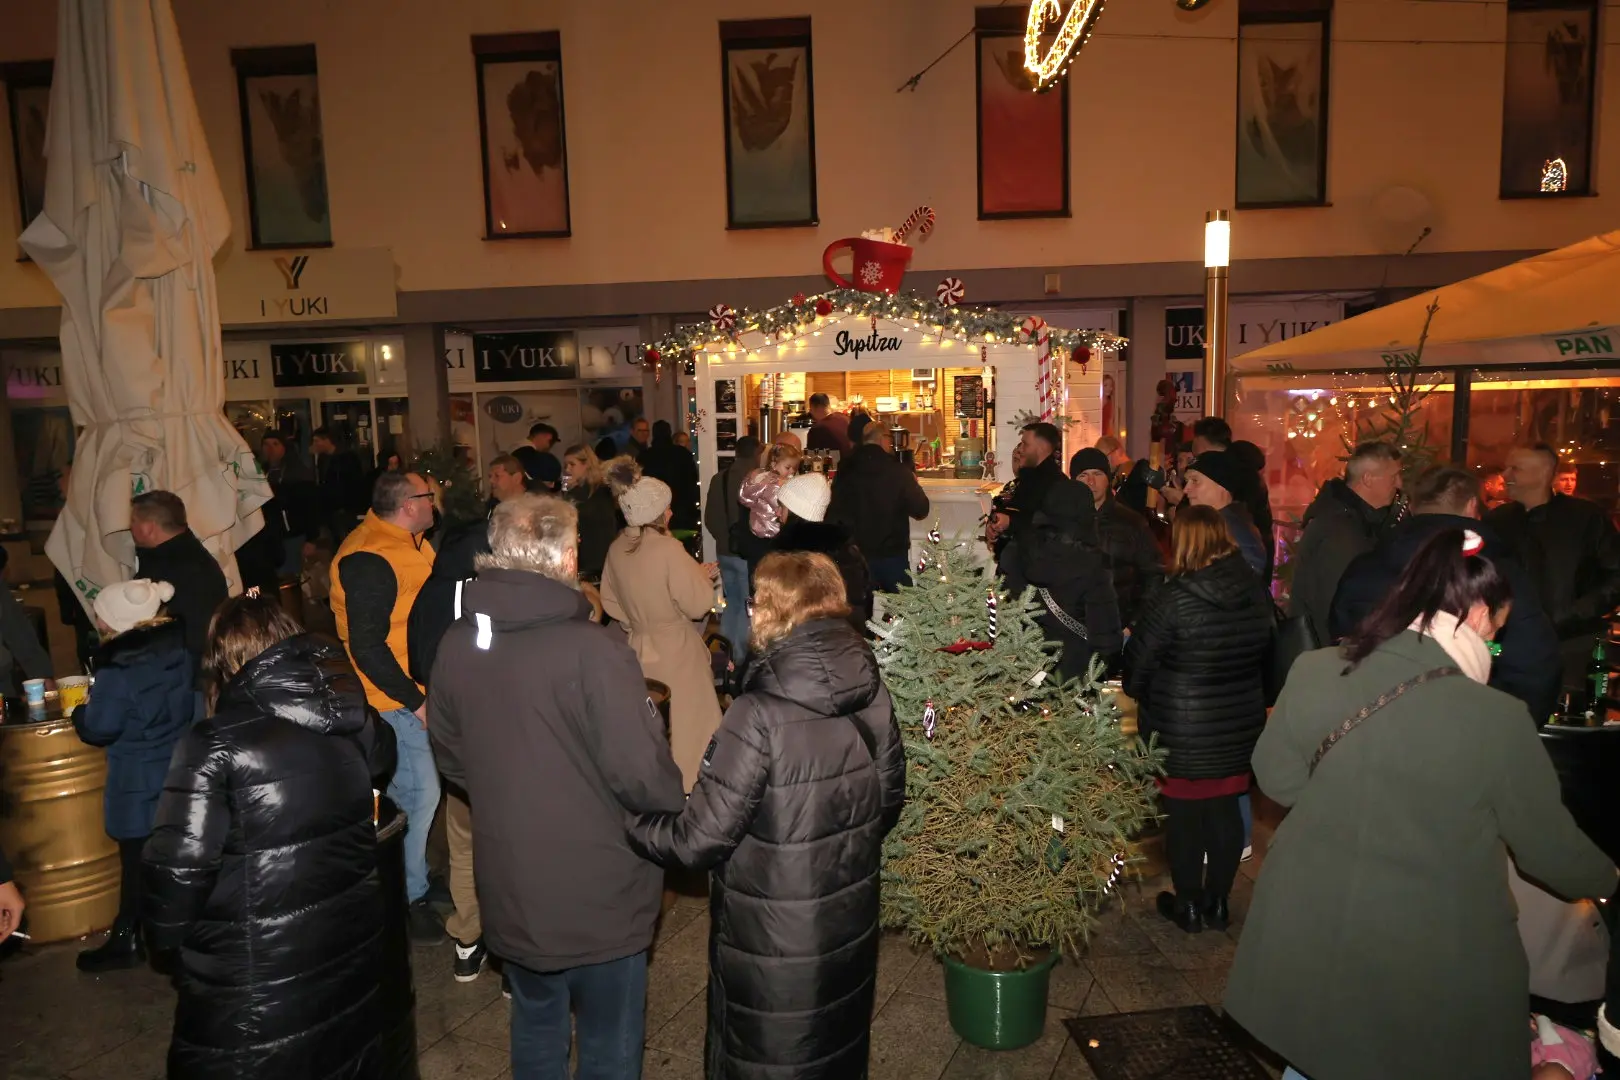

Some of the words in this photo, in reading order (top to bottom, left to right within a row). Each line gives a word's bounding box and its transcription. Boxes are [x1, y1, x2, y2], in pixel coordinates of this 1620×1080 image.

[261, 299, 266, 317] I
[273, 297, 328, 316] YUKI
[1239, 323, 1247, 344] I
[833, 330, 903, 360] Shpitza
[1555, 334, 1613, 356] PAN
[275, 355, 284, 376] I
[290, 350, 359, 375] YUKI
[481, 350, 490, 370] I
[498, 345, 569, 369] YUKI
[587, 346, 593, 367] I
[1381, 352, 1420, 368] PAN
